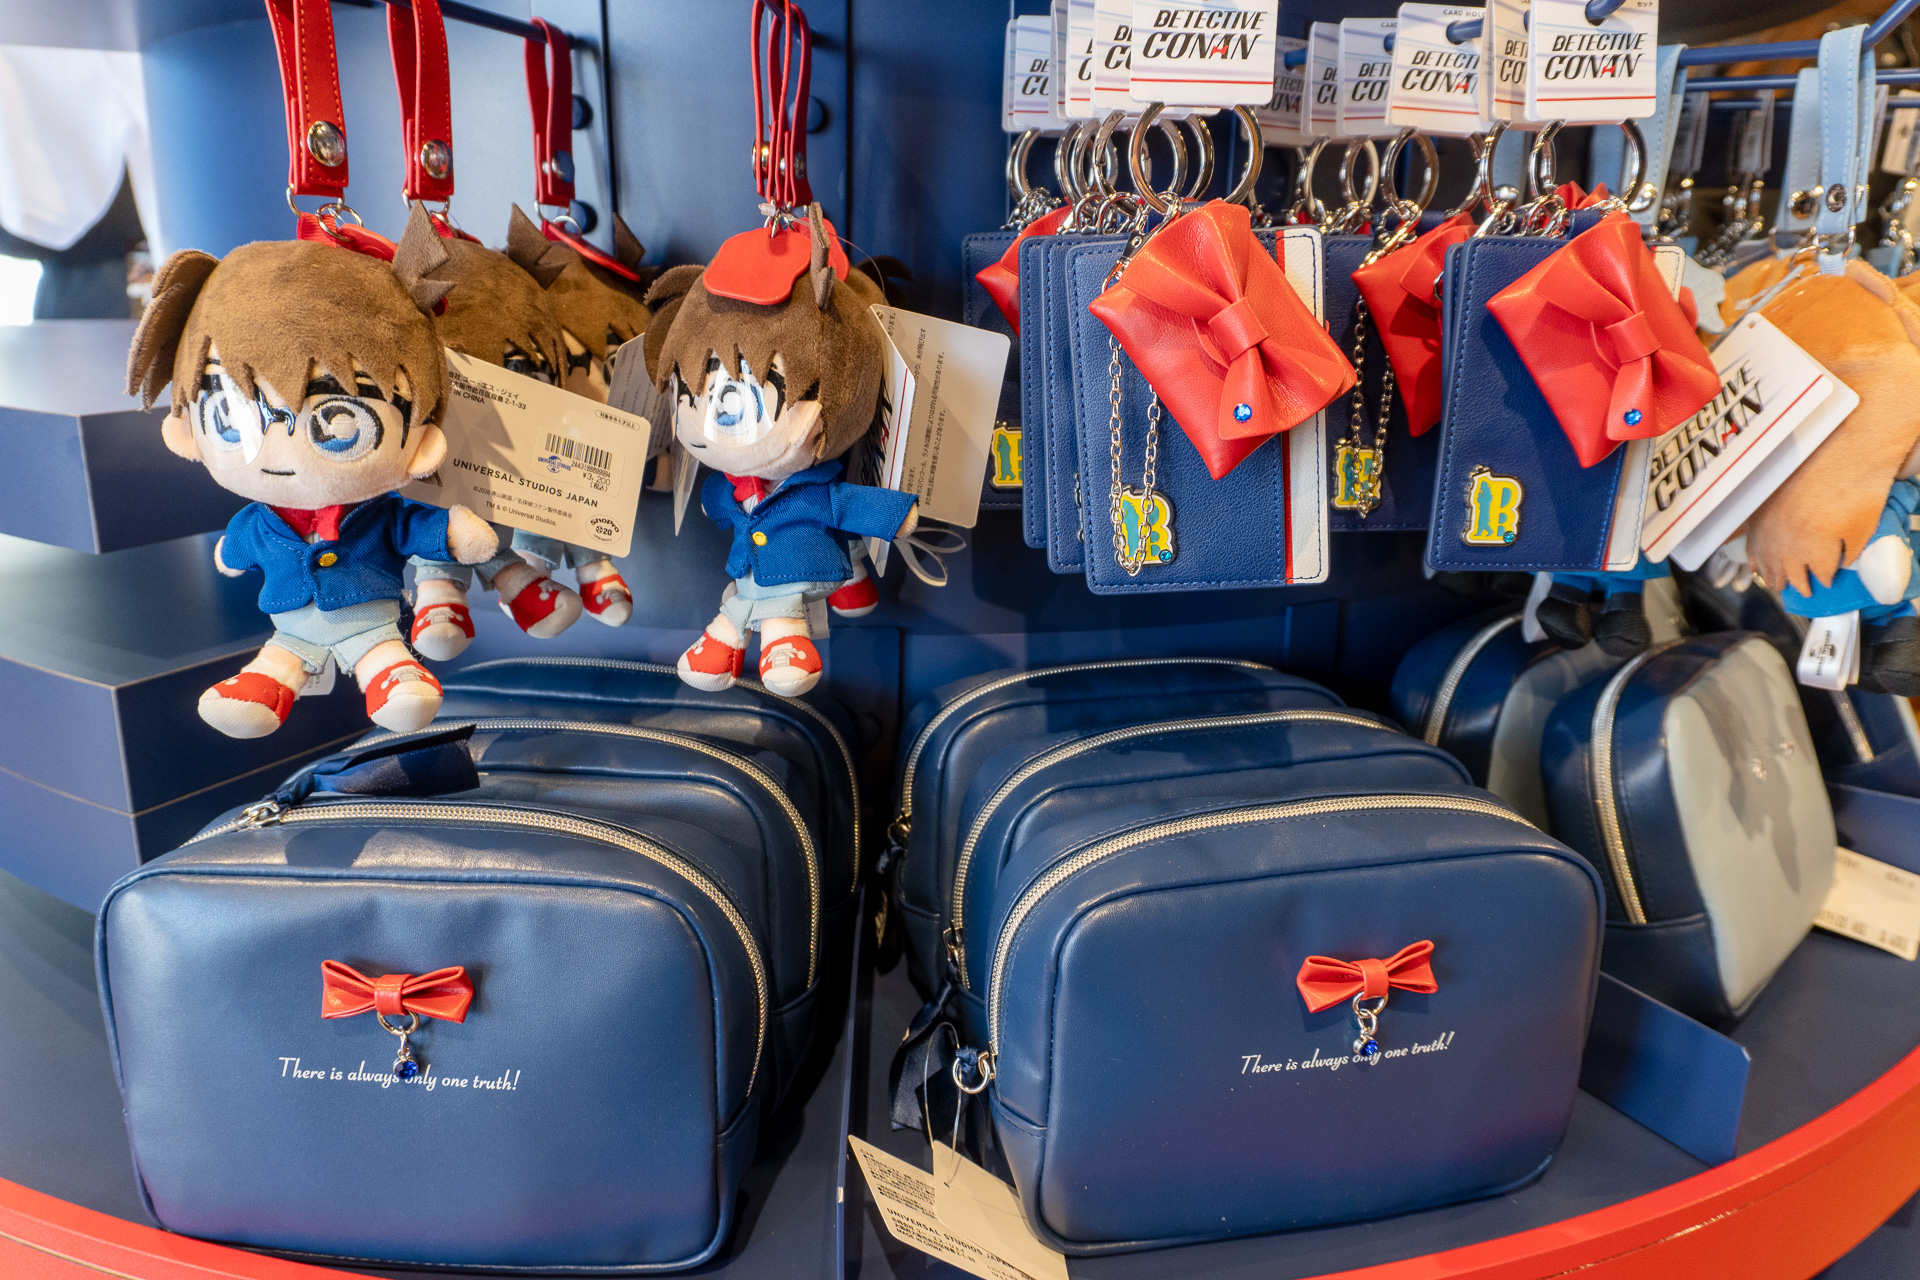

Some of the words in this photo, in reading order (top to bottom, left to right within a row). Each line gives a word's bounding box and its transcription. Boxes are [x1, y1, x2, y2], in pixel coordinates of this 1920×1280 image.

[1153, 9, 1268, 30] DETECTIVE
[1142, 31, 1264, 60] CONAN
[1552, 32, 1648, 52] DETECTIVE
[1411, 50, 1480, 70] DETECTI
[1544, 53, 1646, 80] CONAN
[462, 391, 485, 404] CHINA
[1650, 360, 1755, 483] DETECTIVE
[1655, 379, 1764, 512] CONAN
[453, 458, 514, 483] UNIVERSAL
[519, 477, 562, 497] STUDIOS
[565, 492, 598, 508] JAPAN
[485, 500, 496, 509] TM
[508, 507, 535, 520] Universal
[590, 517, 620, 533] ShoPro
[1241, 1054, 1282, 1074] There
[1286, 1058, 1298, 1071] is
[1301, 1048, 1349, 1071] always
[1384, 1047, 1408, 1059] one
[1411, 1031, 1455, 1055] truth!
[278, 1056, 325, 1080] There
[330, 1067, 343, 1080] is
[347, 1060, 400, 1089] always
[441, 1076, 468, 1088] one
[472, 1069, 521, 1091] truth!
[886, 1207, 941, 1237] UNIVERSAL
[943, 1233, 983, 1255] STUDIOS
